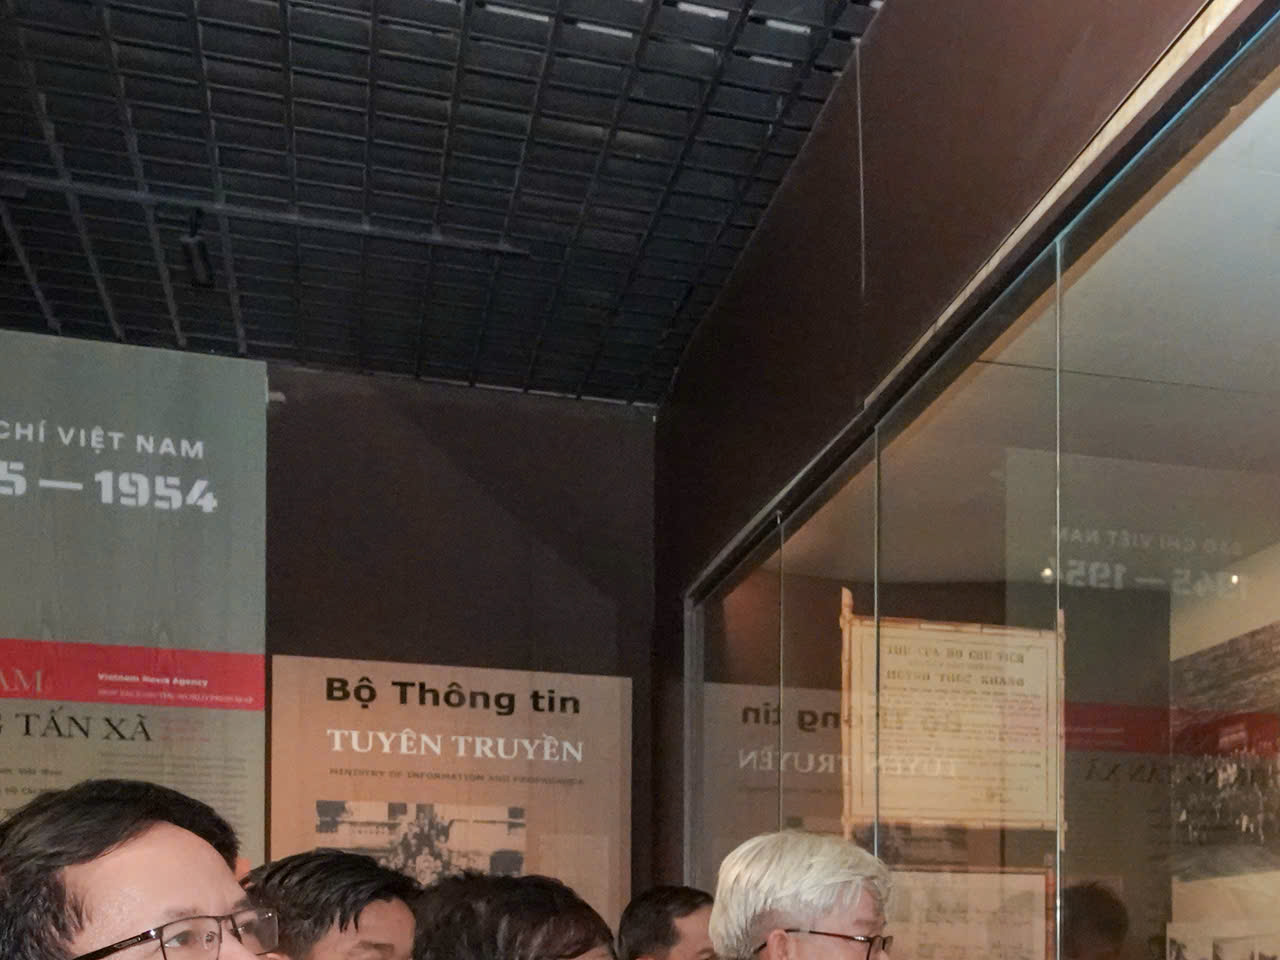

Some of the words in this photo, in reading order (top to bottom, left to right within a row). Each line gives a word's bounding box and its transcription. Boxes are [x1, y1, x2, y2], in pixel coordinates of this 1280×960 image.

[57, 425, 125, 454] VIỆT
[136, 434, 205, 460] NAM
[94, 470, 219, 513] 1954
[325, 676, 377, 709] Bộ
[391, 681, 516, 716] Thông
[529, 689, 580, 714] tin
[15, 706, 92, 739] TẤN
[103, 713, 152, 742] XÃ
[327, 727, 442, 756] TUYÊN
[451, 732, 585, 764] TRUYỀN
